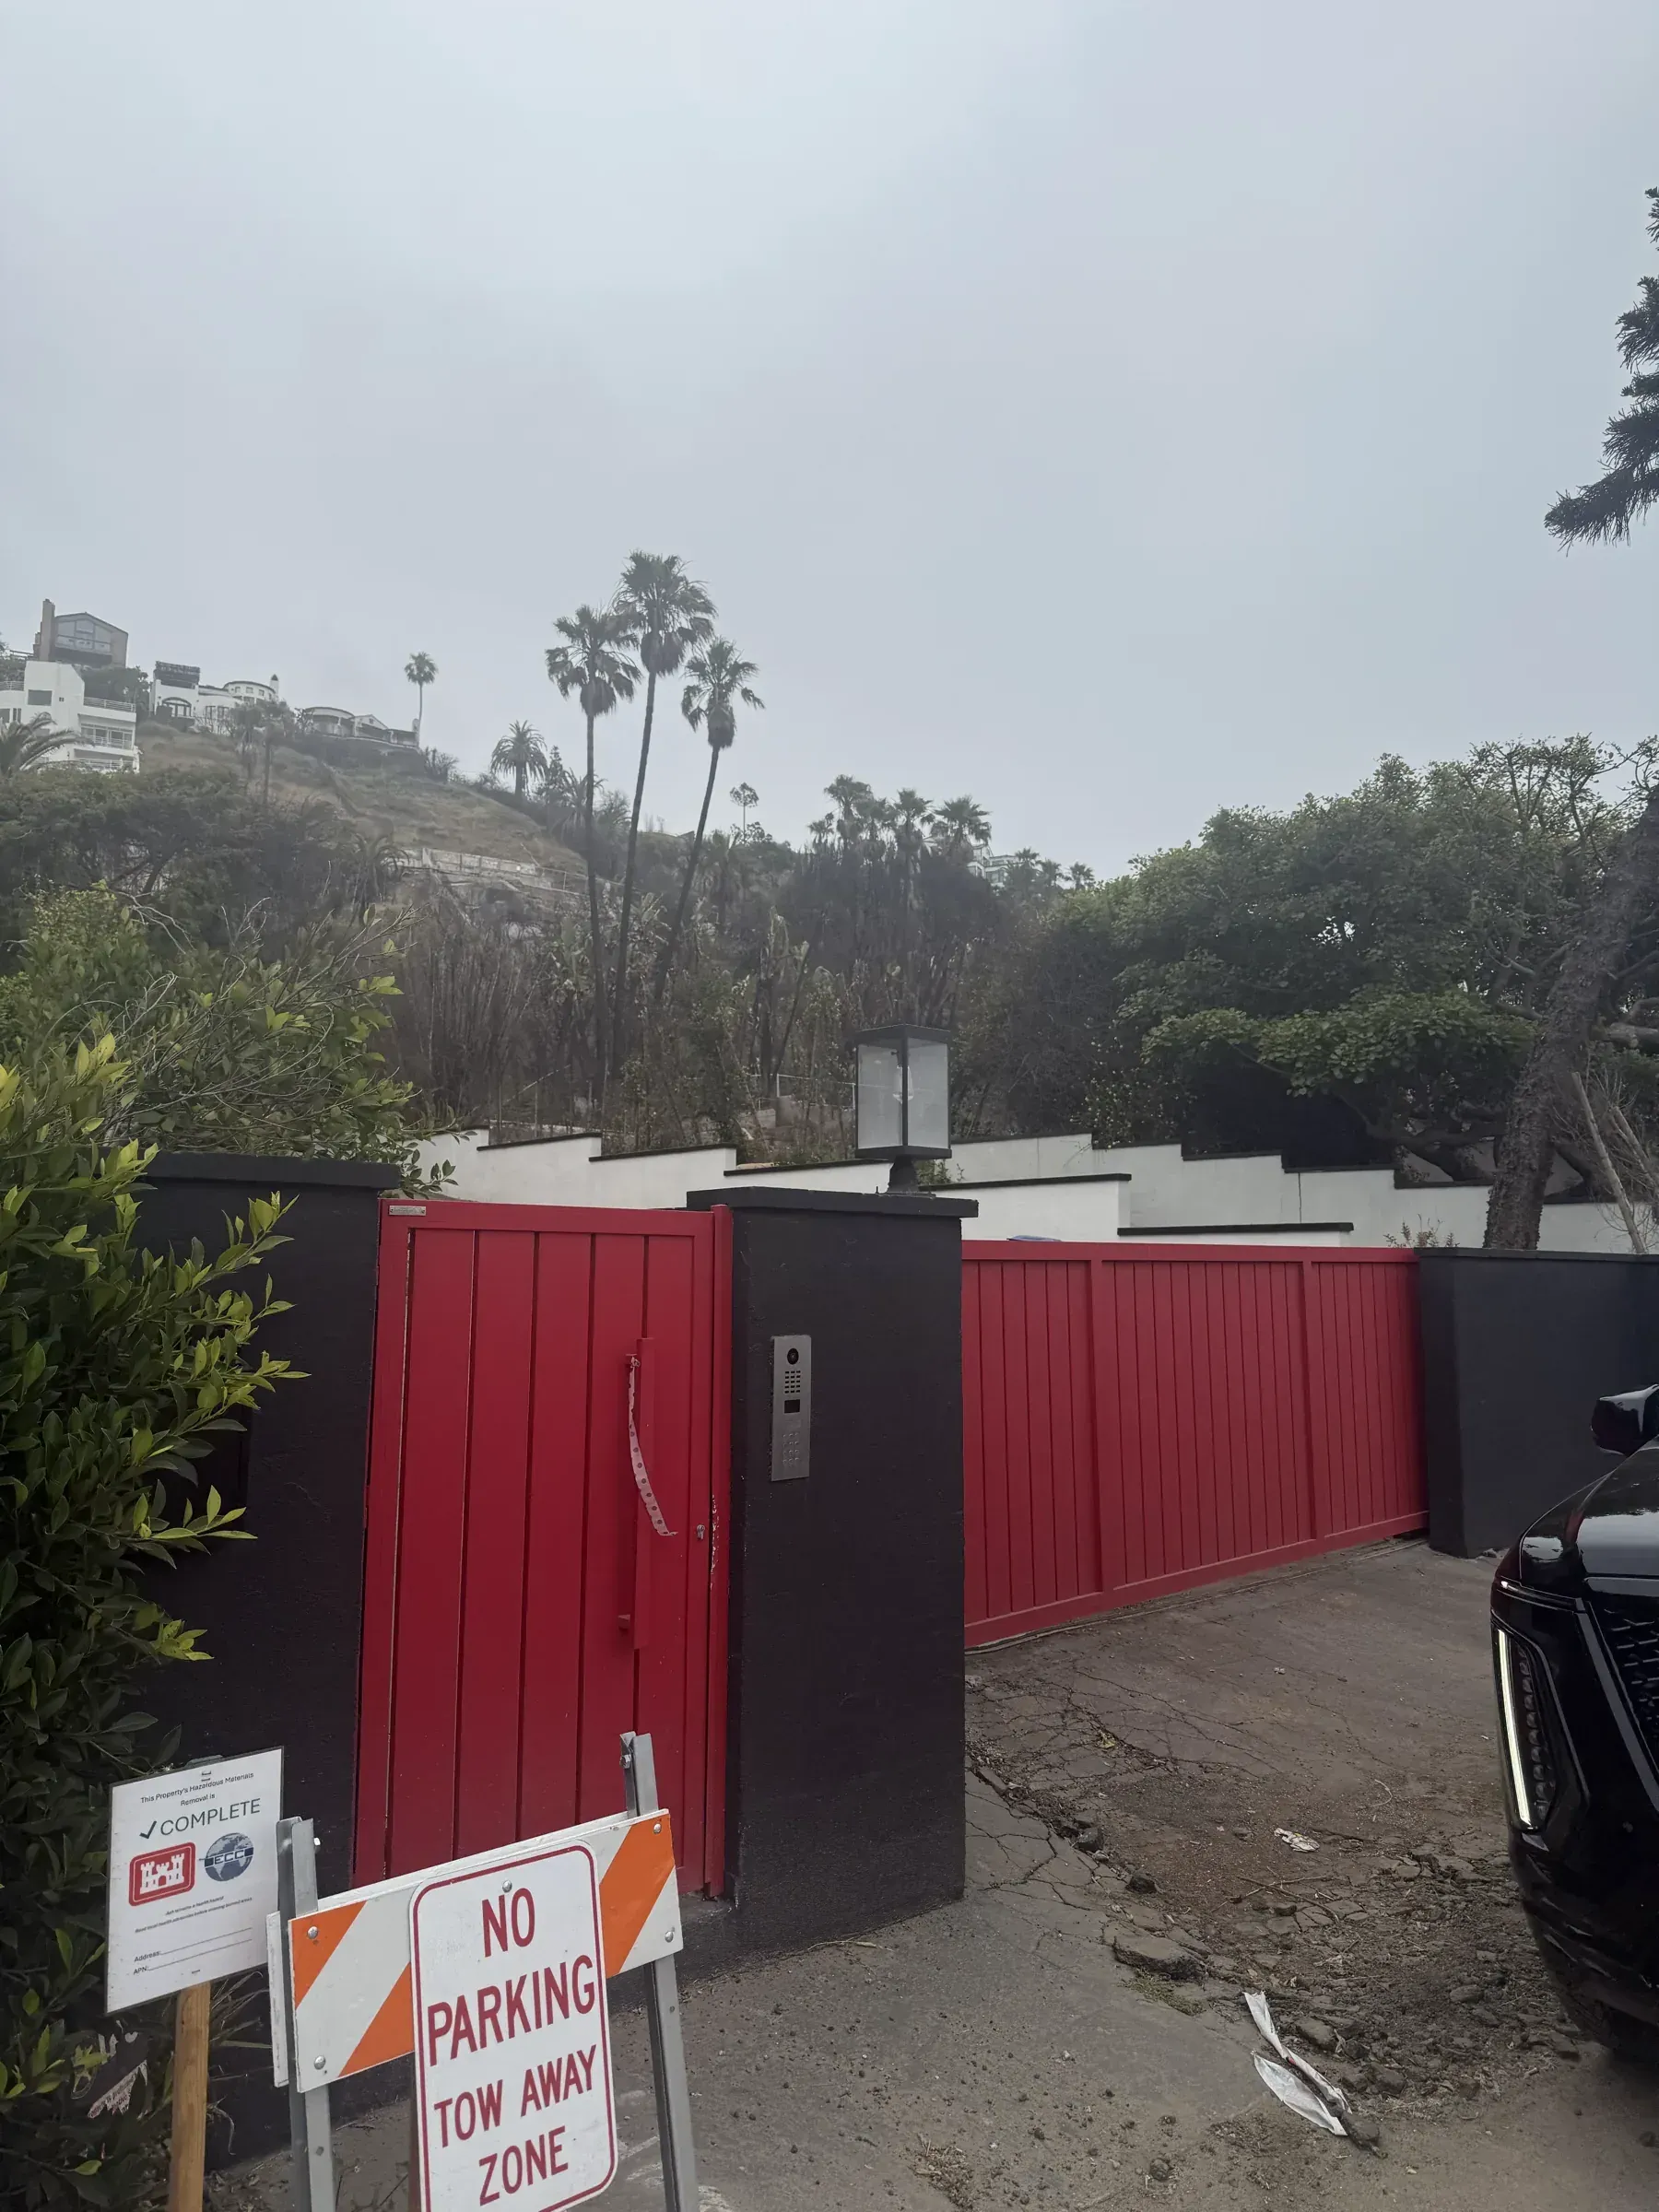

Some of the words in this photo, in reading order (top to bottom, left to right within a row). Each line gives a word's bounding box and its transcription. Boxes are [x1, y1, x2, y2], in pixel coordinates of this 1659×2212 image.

[155, 1787, 189, 1800] Property's
[189, 1780, 224, 1792] Hazardous
[225, 1772, 254, 1783] Materials
[181, 1794, 208, 1806] Removal
[160, 1798, 261, 1836] COMPLETE
[214, 1849, 244, 1865] ECC
[482, 1888, 535, 1958] NO
[133, 1965, 149, 1975] APN:
[134, 1950, 161, 1962] Address:
[428, 1955, 595, 2066] PARKING
[434, 2079, 503, 2148] TOW
[521, 2044, 596, 2117] AWAY
[479, 2125, 569, 2206] ZONE
